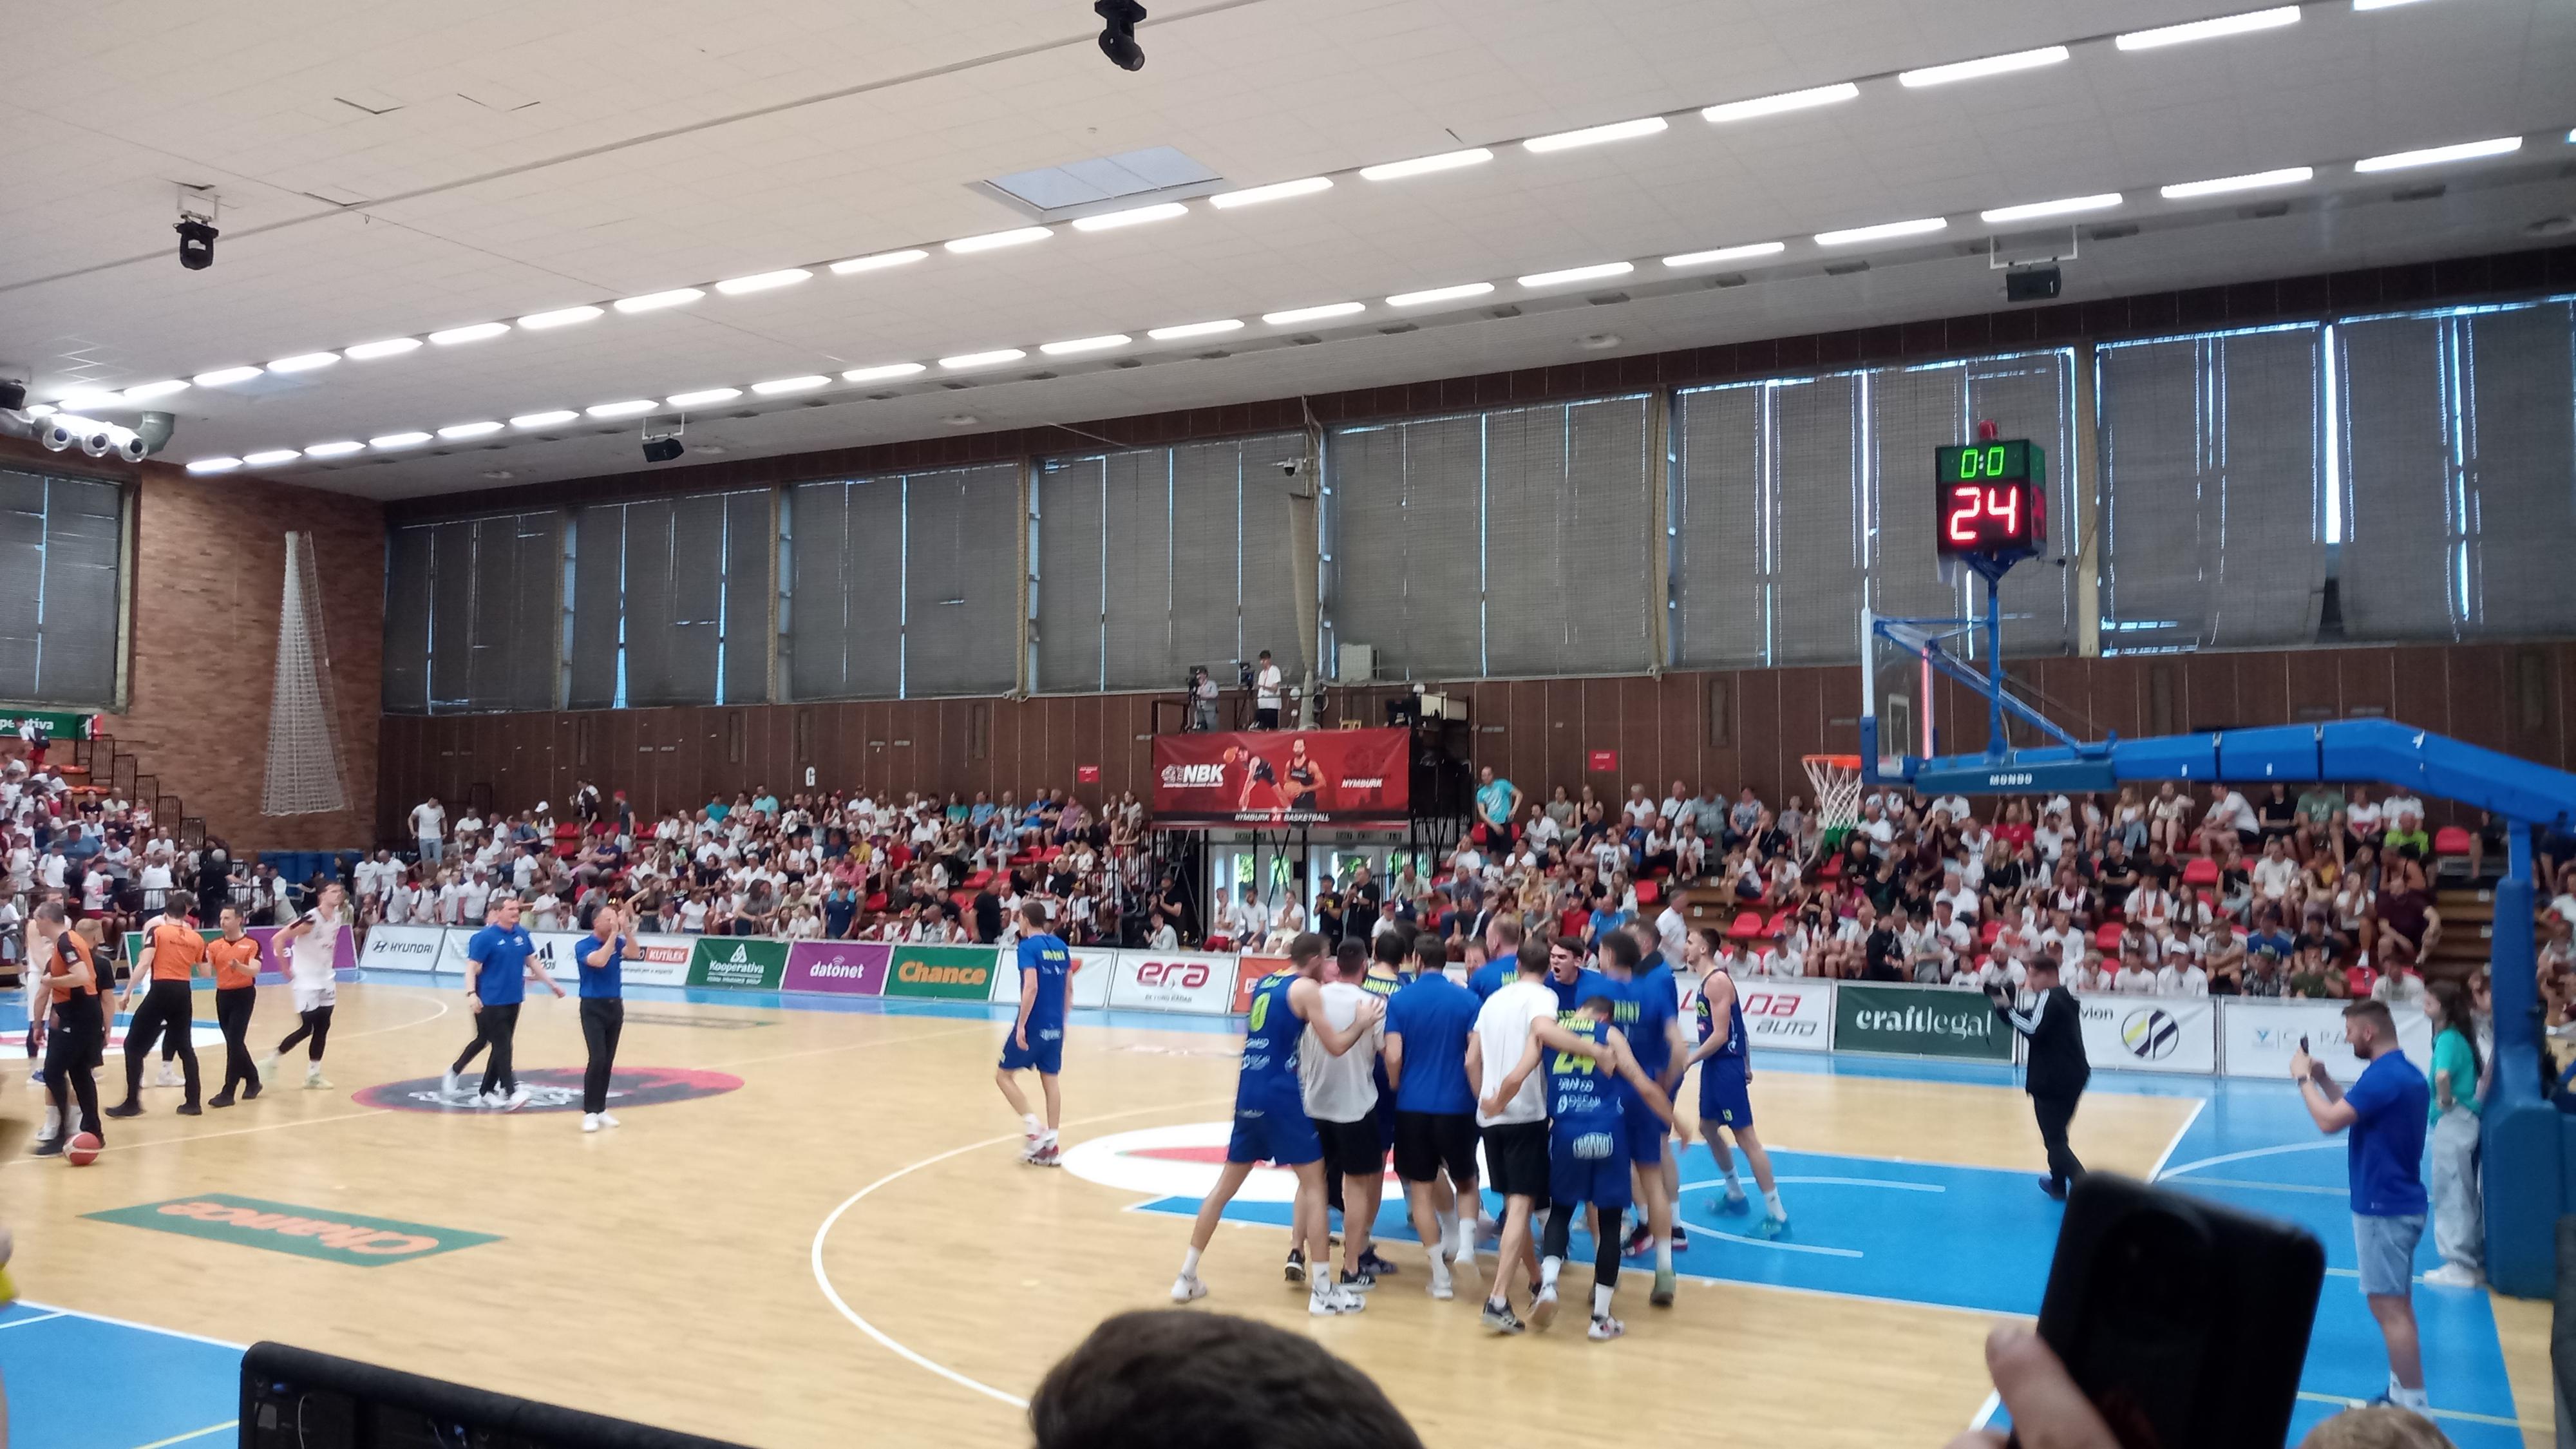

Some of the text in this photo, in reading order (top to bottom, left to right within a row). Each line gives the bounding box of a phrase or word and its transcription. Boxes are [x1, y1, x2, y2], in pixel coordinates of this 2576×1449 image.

[1960, 446, 2005, 478] 0:0
[1950, 486, 2017, 540] 24
[805, 766, 815, 787] G
[1182, 764, 1226, 782] NBK
[1989, 773, 2033, 786] MONDO
[1341, 778, 1383, 789] NYMBURK
[1235, 813, 1270, 822] NYMBURK
[1283, 813, 1330, 822] BASKETBALL
[390, 942, 433, 954] HYUNDAI
[708, 959, 765, 974] Kooperativa
[810, 960, 864, 979] datonet
[898, 960, 987, 985] Chance
[1136, 961, 1210, 989] era
[2080, 1005, 2114, 1021] vion
[1855, 1005, 1993, 1041] craftlegal
